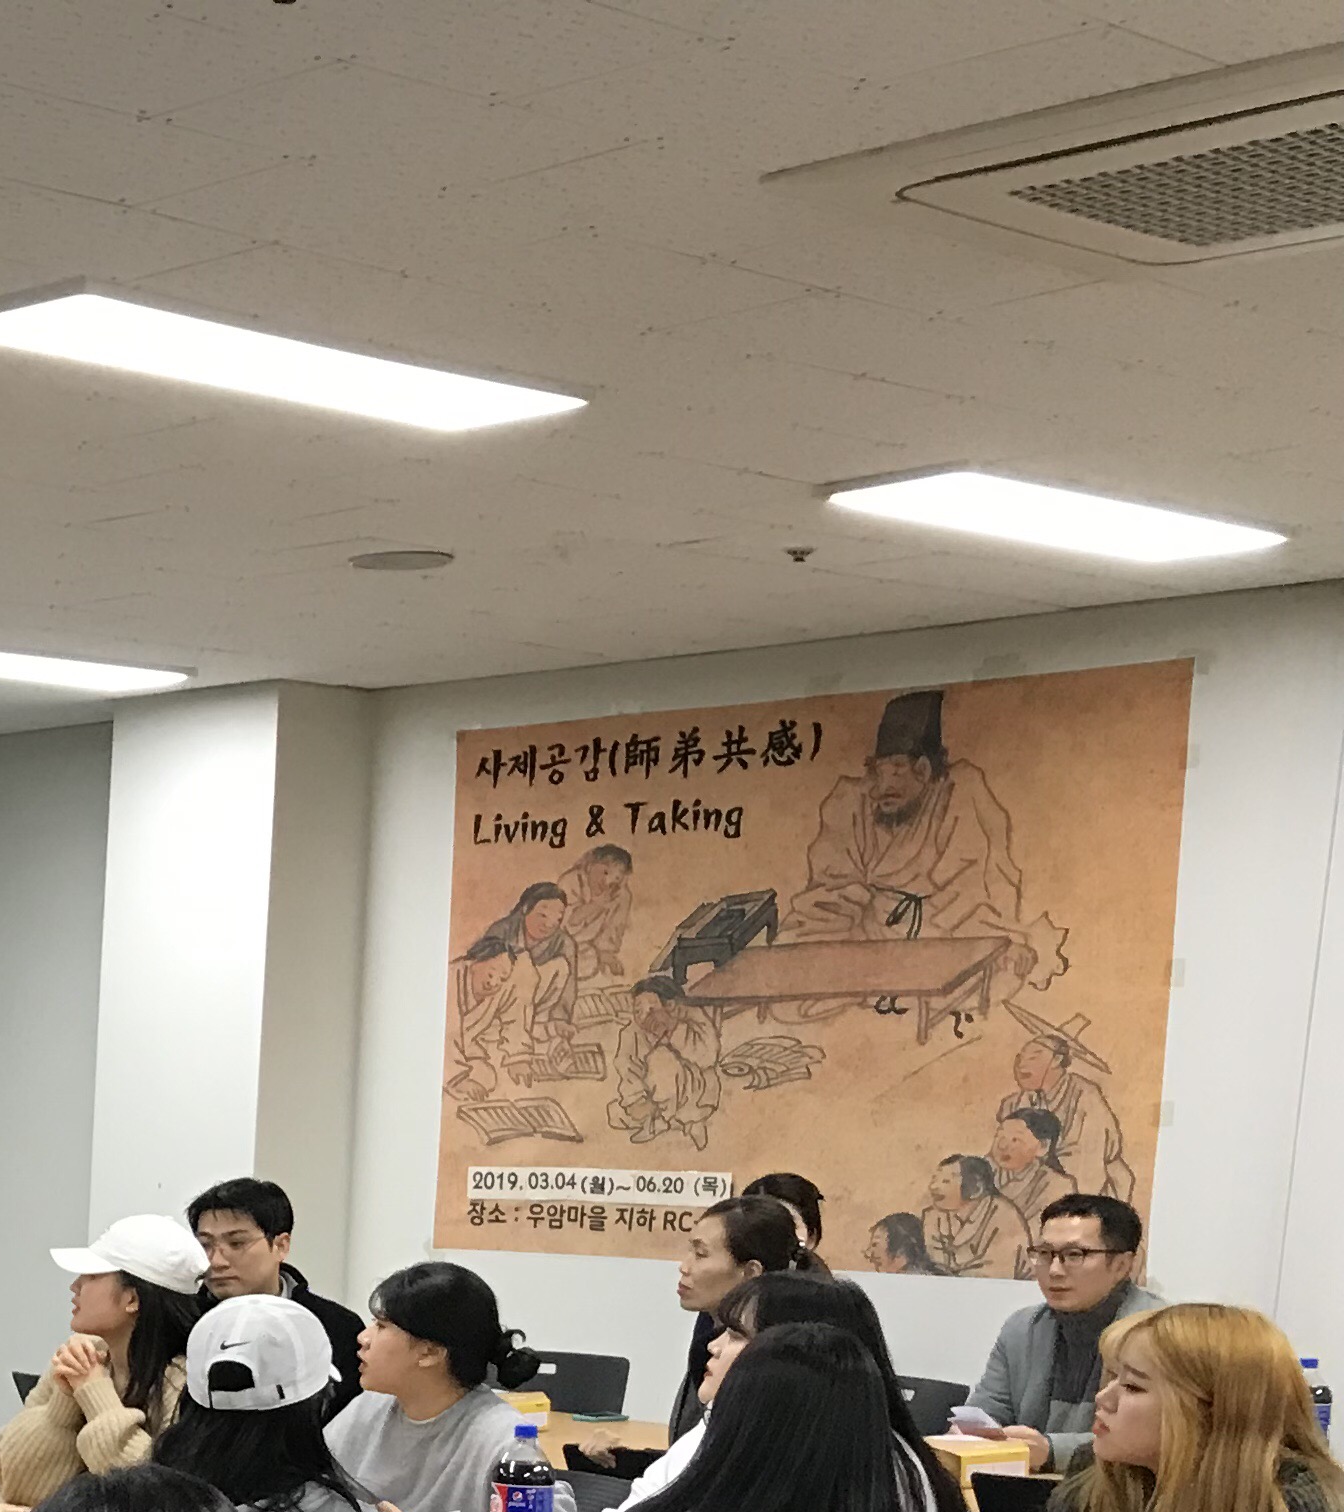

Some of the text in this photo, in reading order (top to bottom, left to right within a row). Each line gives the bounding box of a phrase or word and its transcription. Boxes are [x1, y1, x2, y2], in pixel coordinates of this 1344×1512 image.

[473, 798, 744, 849] Living & Taking
[636, 1175, 684, 1195] 06.20
[693, 1176, 727, 1198] (목)
[467, 1201, 508, 1227] 장소
[526, 1203, 608, 1232] 우암마을
[614, 1206, 656, 1233] 지하
